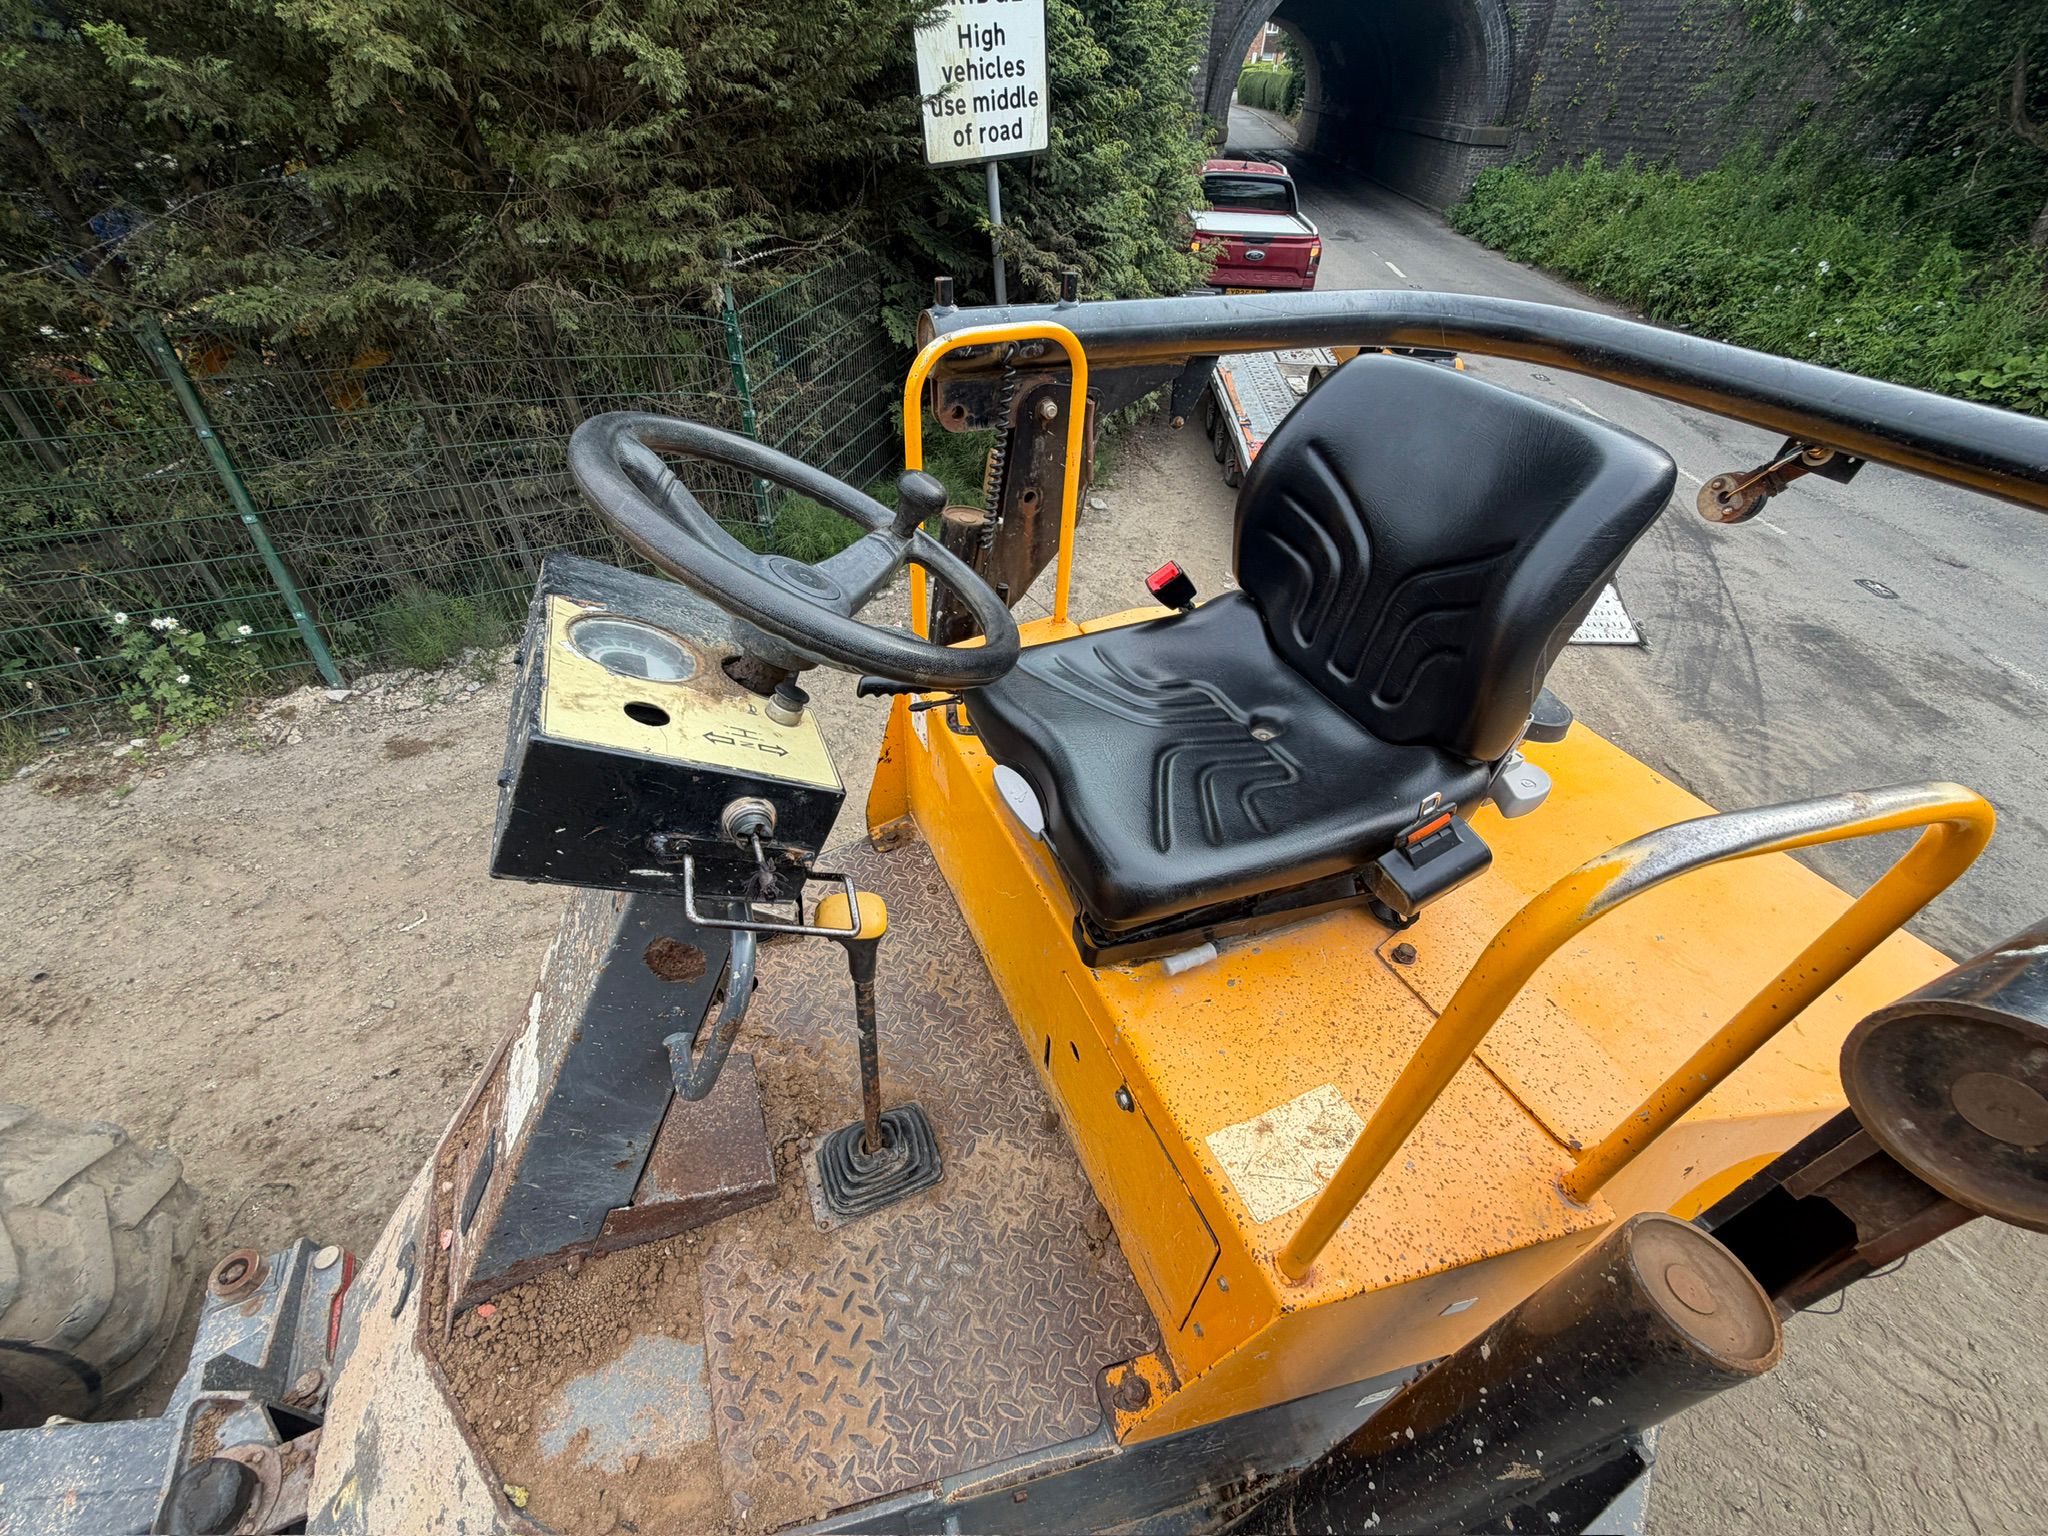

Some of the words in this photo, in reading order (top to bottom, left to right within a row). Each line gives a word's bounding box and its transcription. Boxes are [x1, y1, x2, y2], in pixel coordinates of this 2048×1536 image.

[957, 22, 1006, 52] High
[941, 55, 1026, 84] vehicles
[930, 97, 967, 118] use
[973, 85, 1039, 114] middle
[953, 122, 973, 147] of
[979, 116, 1023, 144] road
[1209, 273, 1295, 283] ANGER
